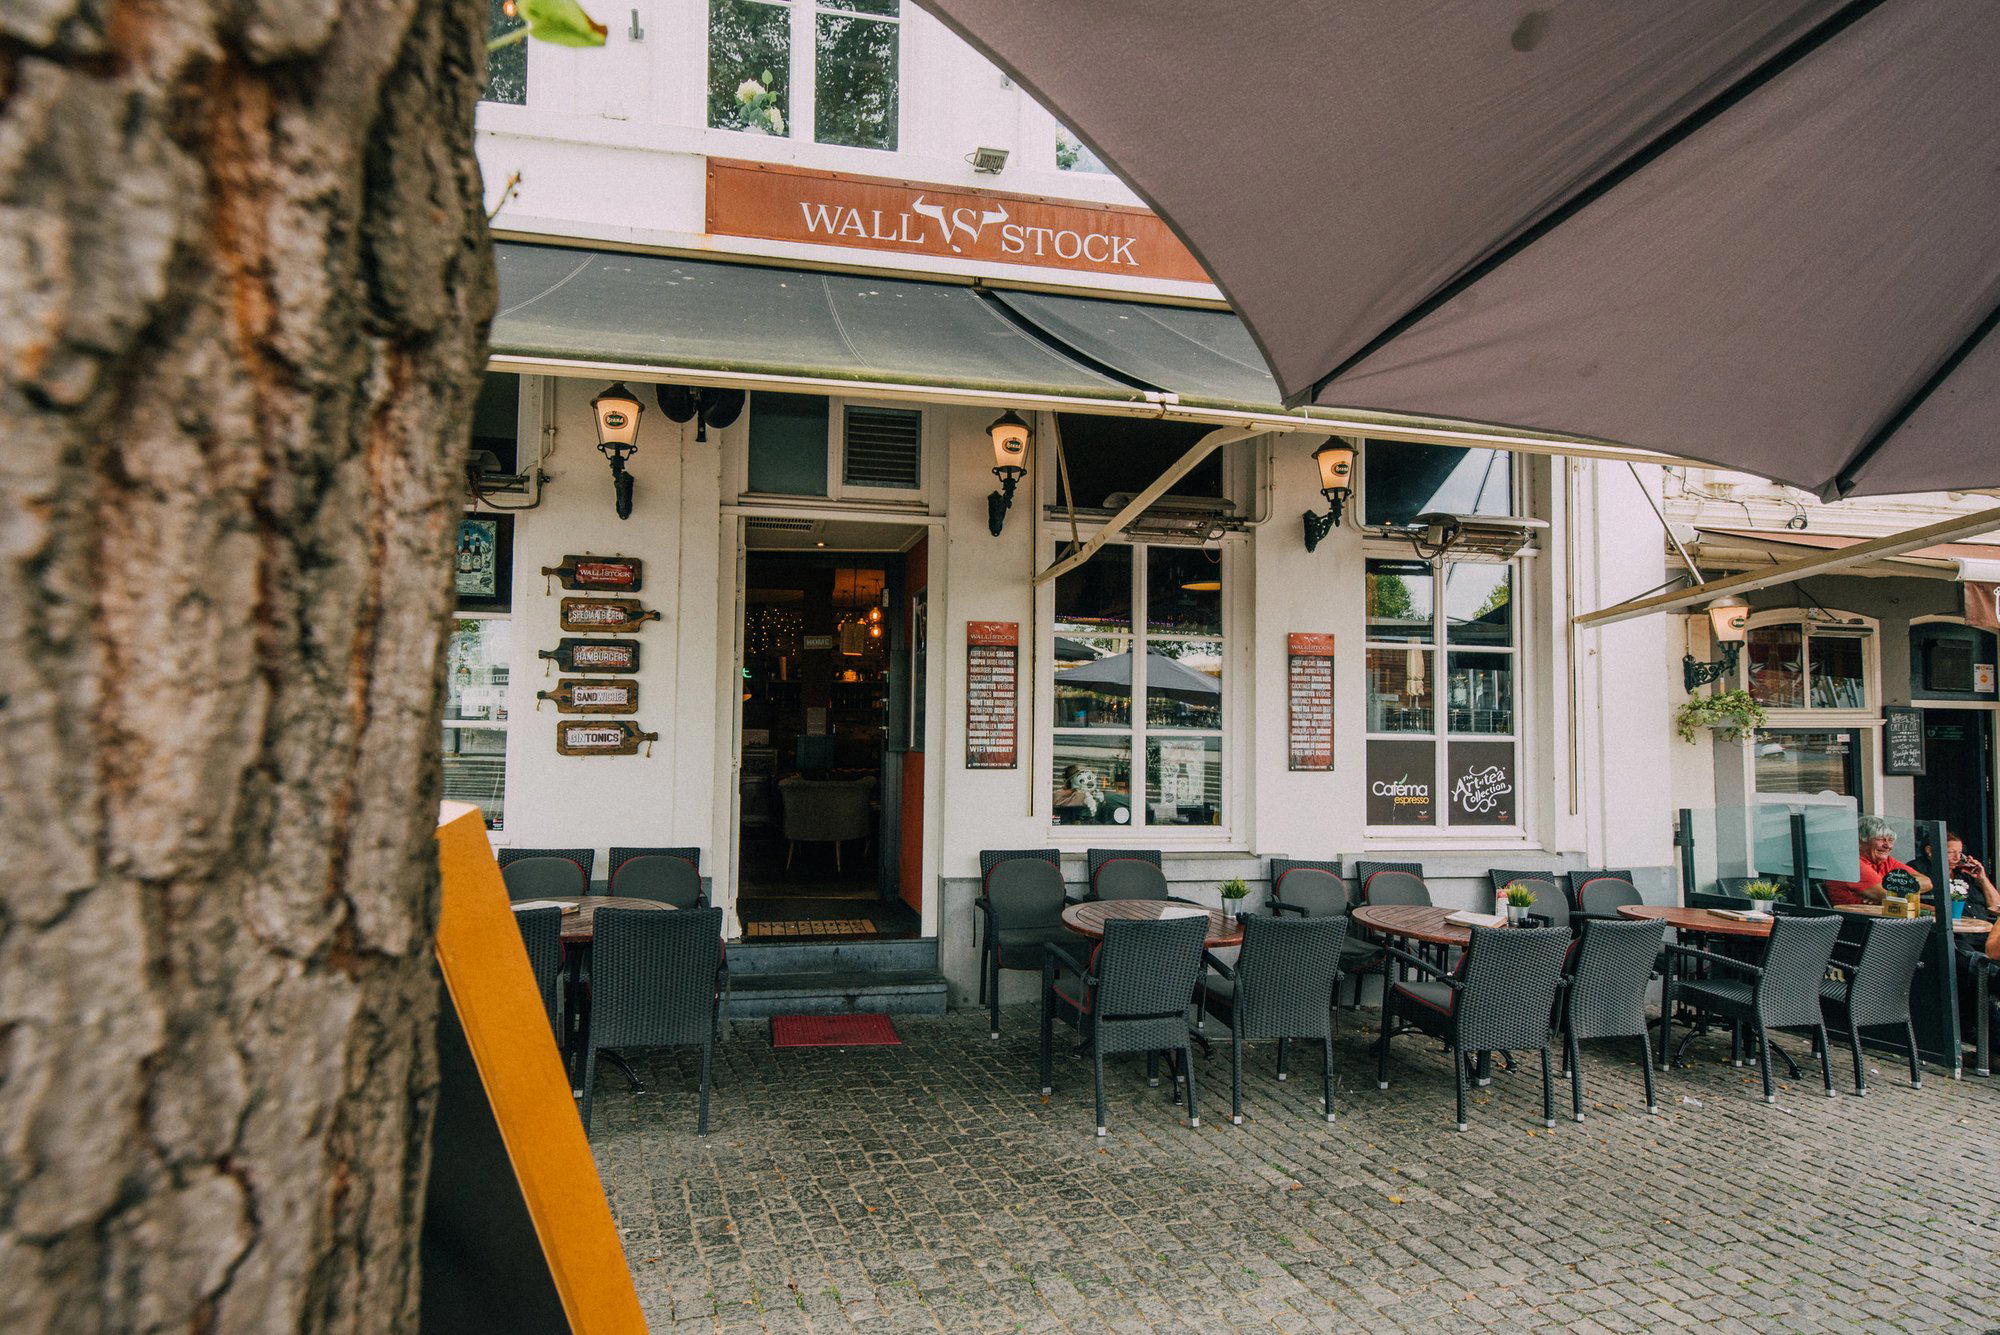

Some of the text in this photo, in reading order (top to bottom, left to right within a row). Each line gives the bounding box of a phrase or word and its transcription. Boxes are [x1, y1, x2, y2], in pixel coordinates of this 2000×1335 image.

[800, 201, 925, 244] WALL
[1001, 223, 1140, 267] STOCK
[576, 651, 628, 662] HAMBURGERS
[1394, 796, 1430, 805] espresso
[1451, 777, 1480, 802] Art
[1484, 770, 1506, 785] tea
[1463, 783, 1512, 812] Collection
